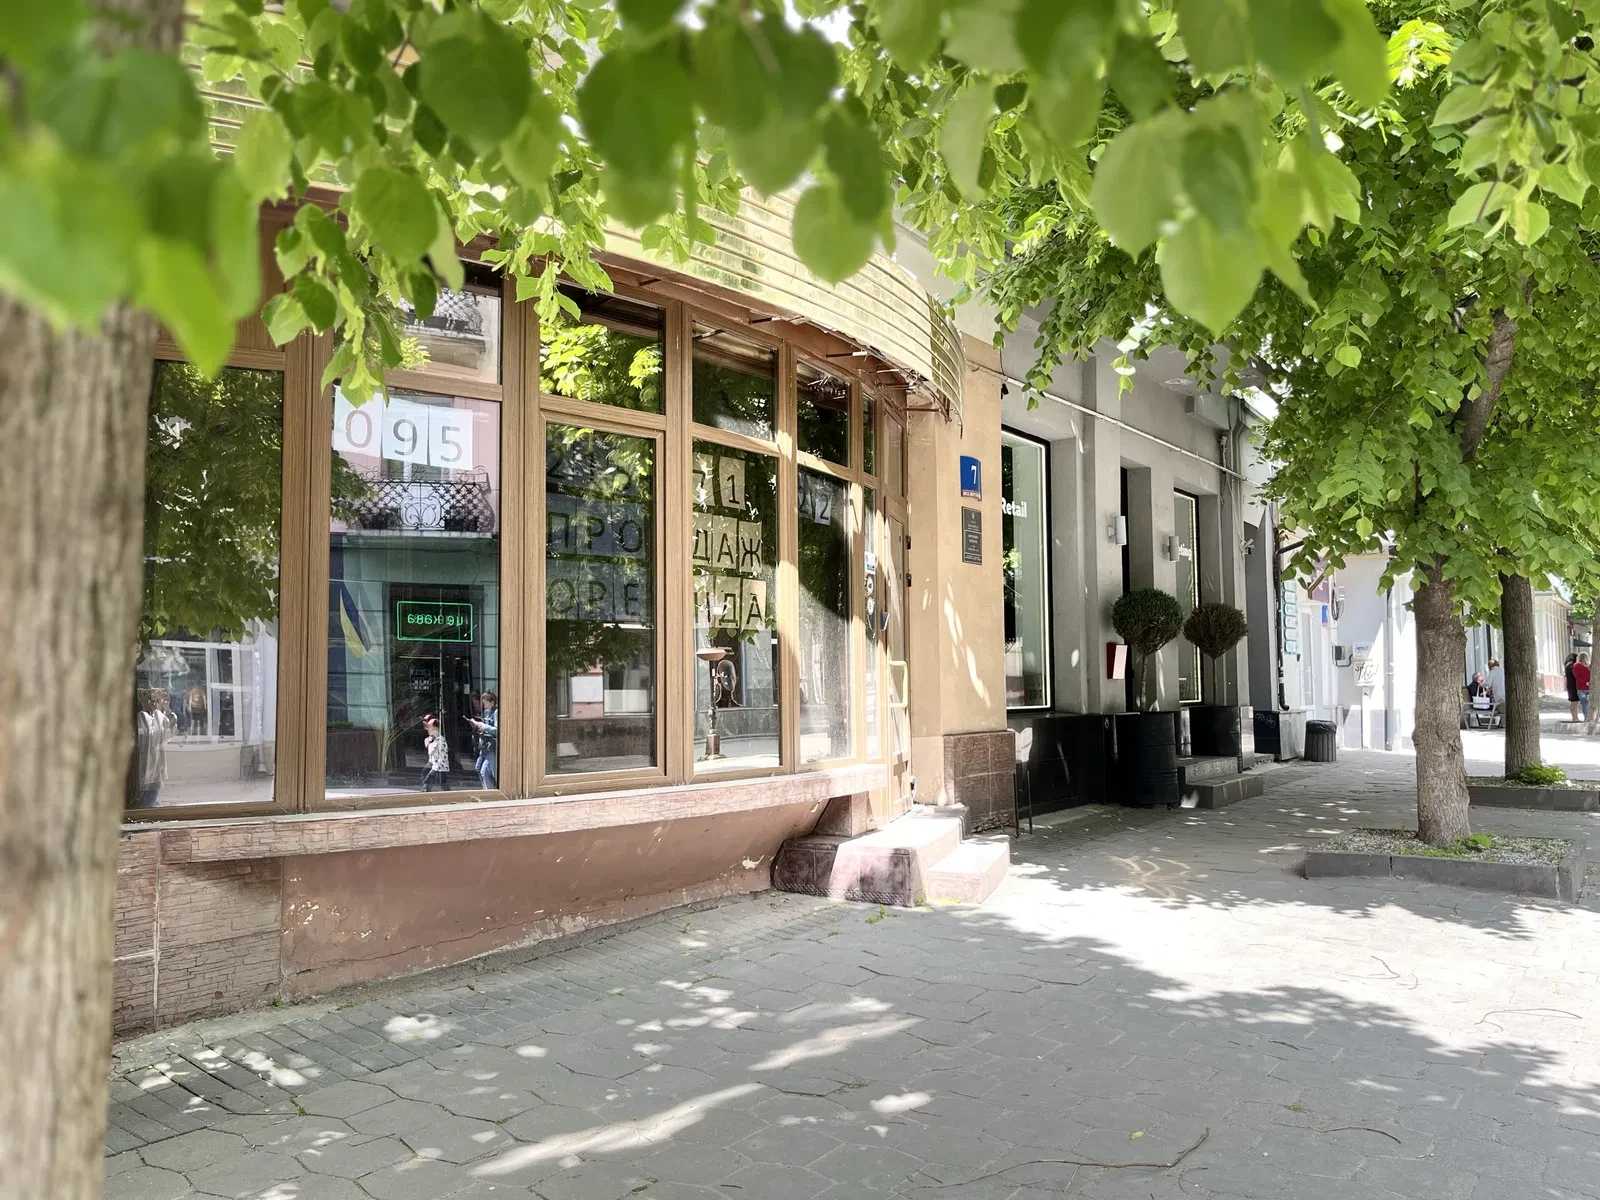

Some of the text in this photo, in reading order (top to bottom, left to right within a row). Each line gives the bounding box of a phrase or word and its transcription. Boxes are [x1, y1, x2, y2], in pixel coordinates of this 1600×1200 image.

[345, 409, 464, 463] 095
[970, 464, 977, 485] 7
[1001, 496, 1028, 518] Retail
